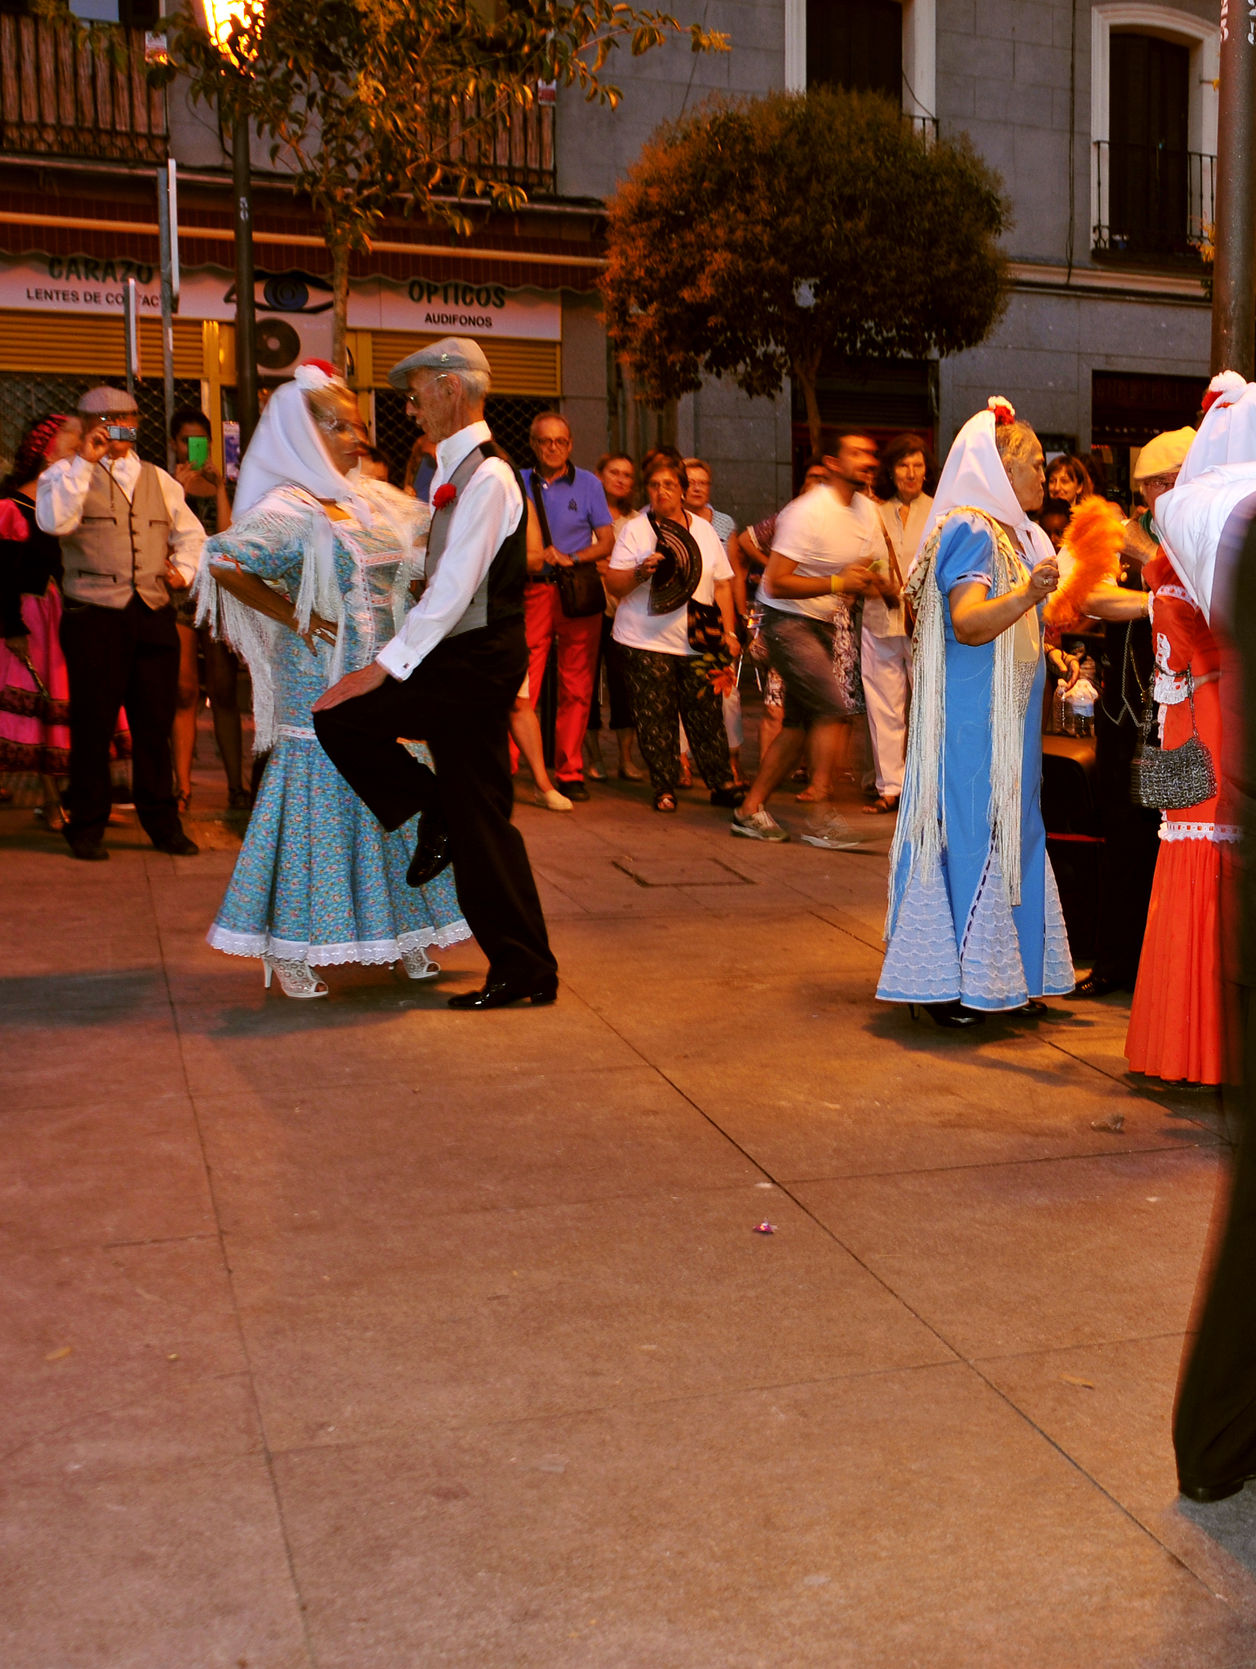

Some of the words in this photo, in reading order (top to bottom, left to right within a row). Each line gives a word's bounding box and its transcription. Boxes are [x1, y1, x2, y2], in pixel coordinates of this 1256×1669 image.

[26, 288, 79, 302] LENTES
[84, 292, 101, 304] DE
[408, 280, 506, 308] OPTICOS
[425, 313, 492, 327] AUDIFONOS
